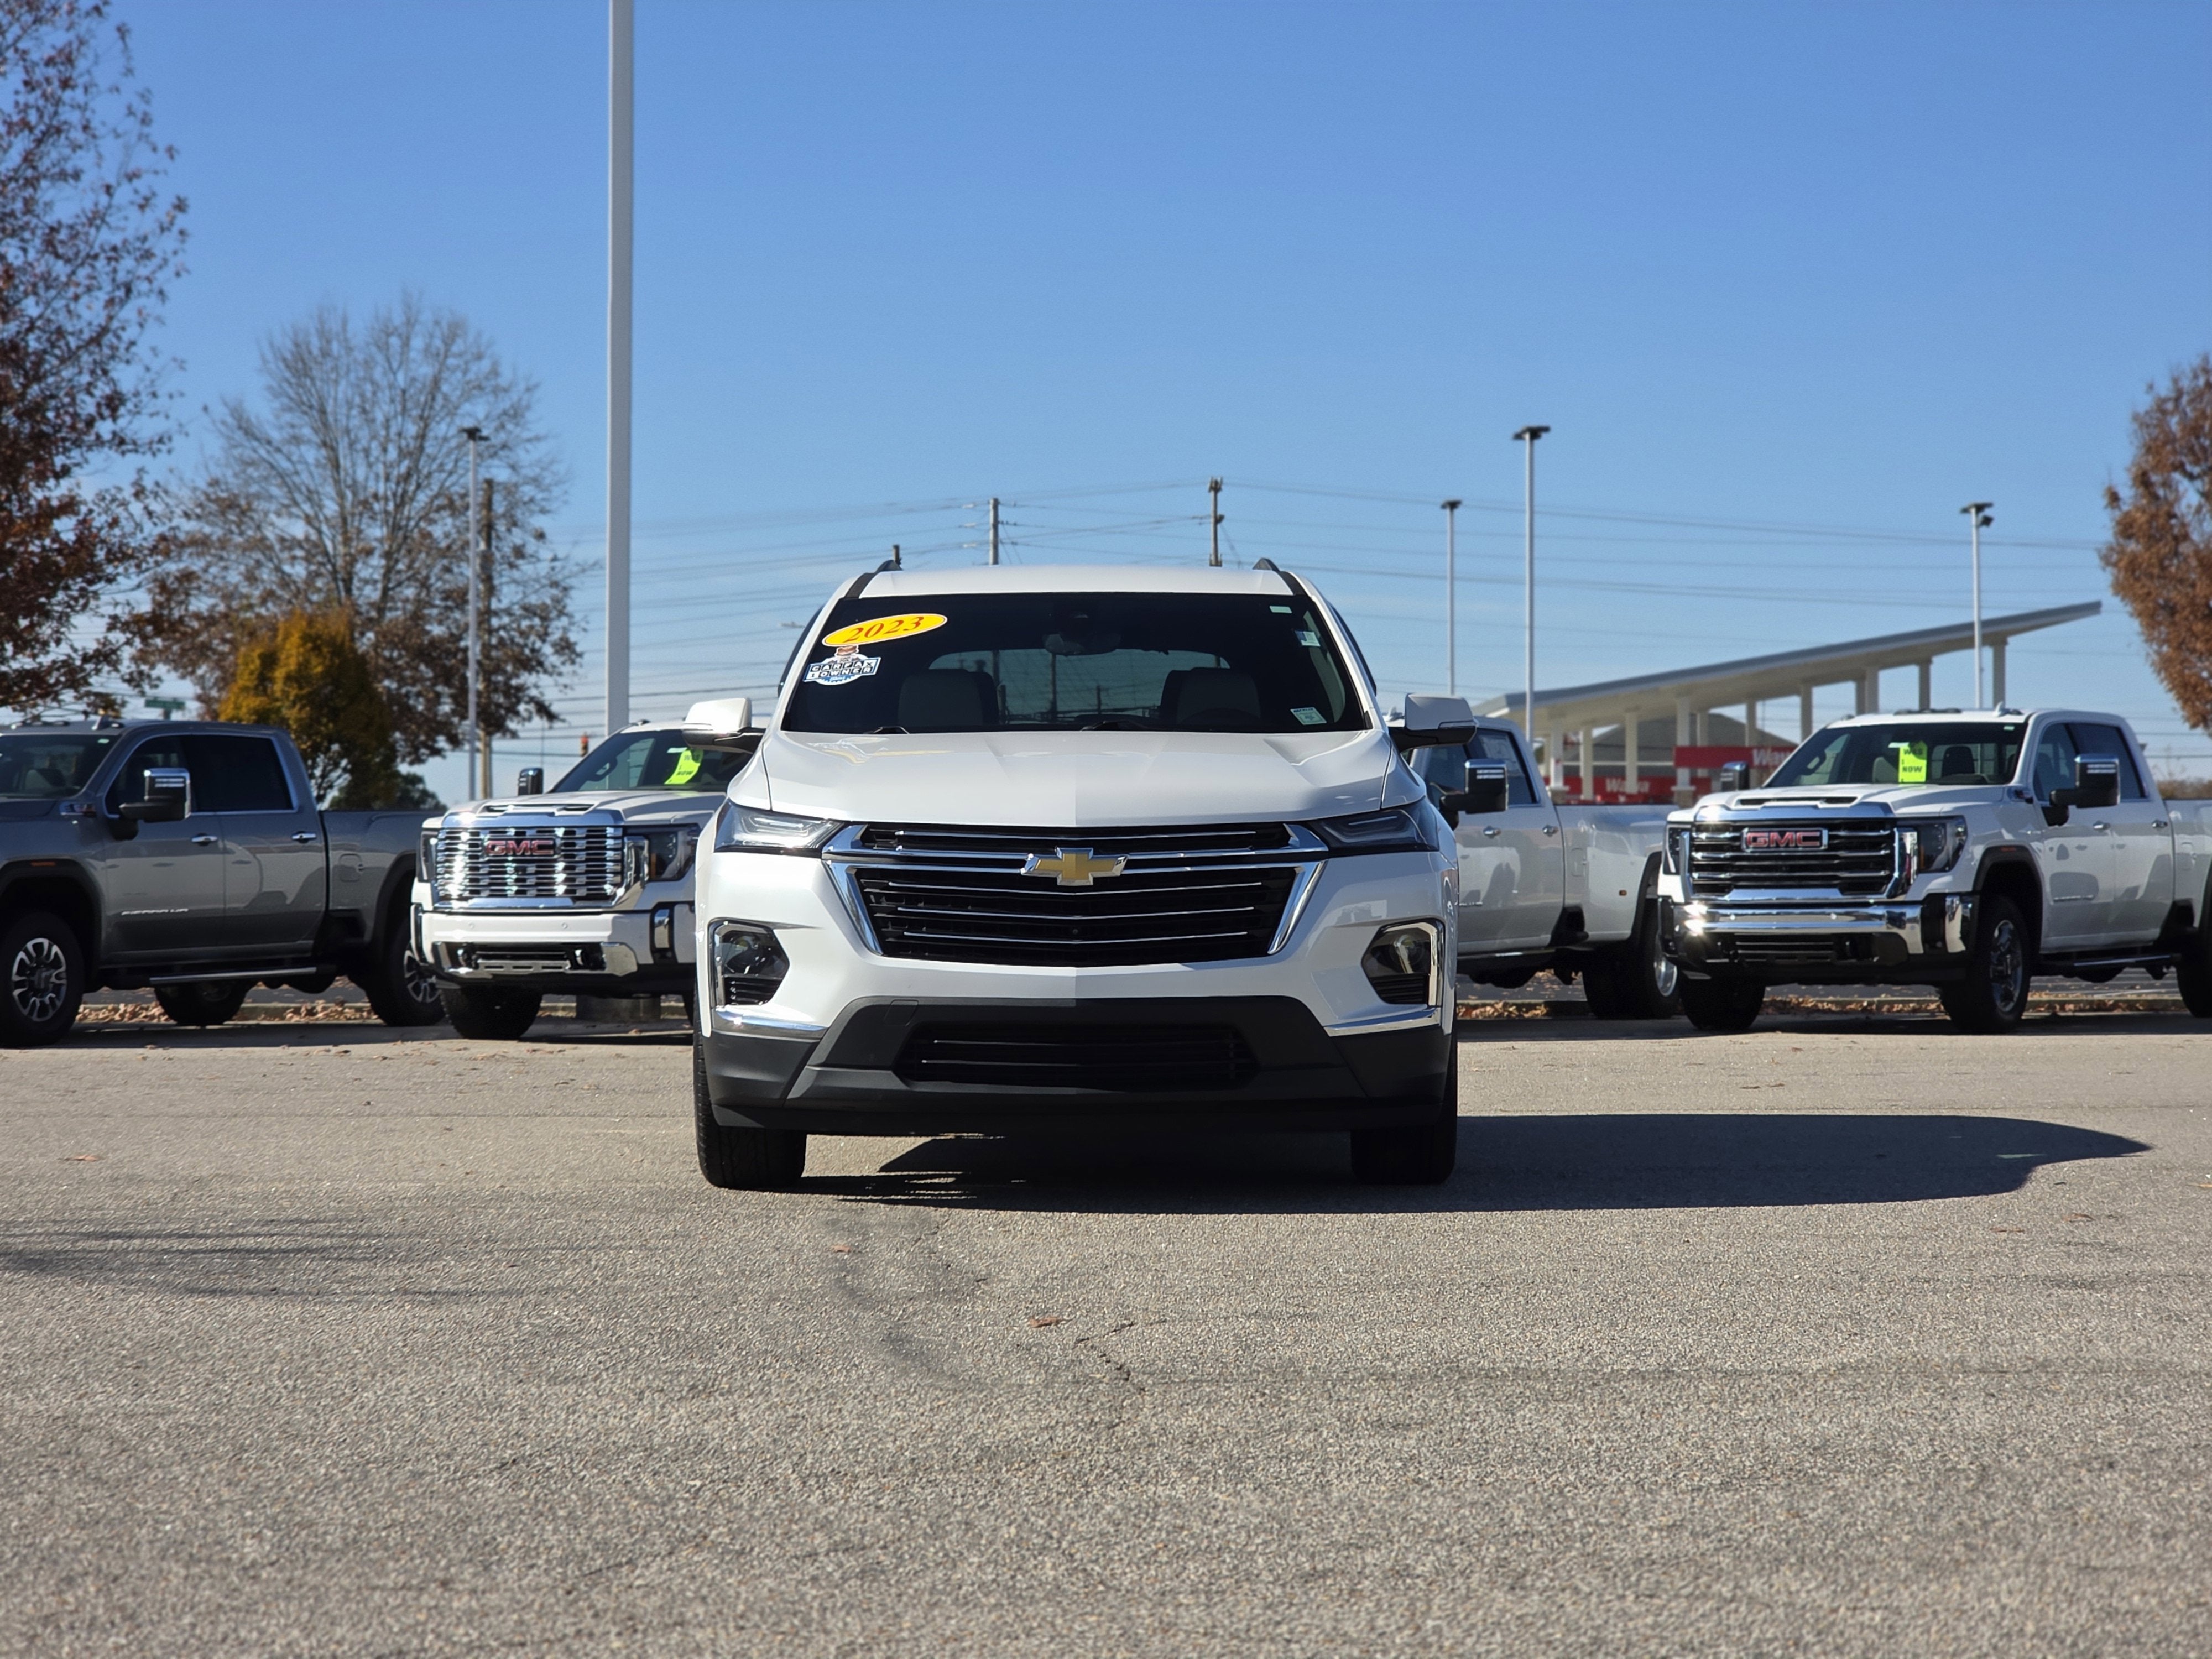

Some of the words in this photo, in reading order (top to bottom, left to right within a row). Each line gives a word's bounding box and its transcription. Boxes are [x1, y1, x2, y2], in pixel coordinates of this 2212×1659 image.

[843, 617, 924, 643] 2023
[811, 660, 873, 671] CARFAX
[819, 667, 872, 677] OWNER
[1747, 832, 1820, 847] GMC
[487, 840, 554, 855] GMC
